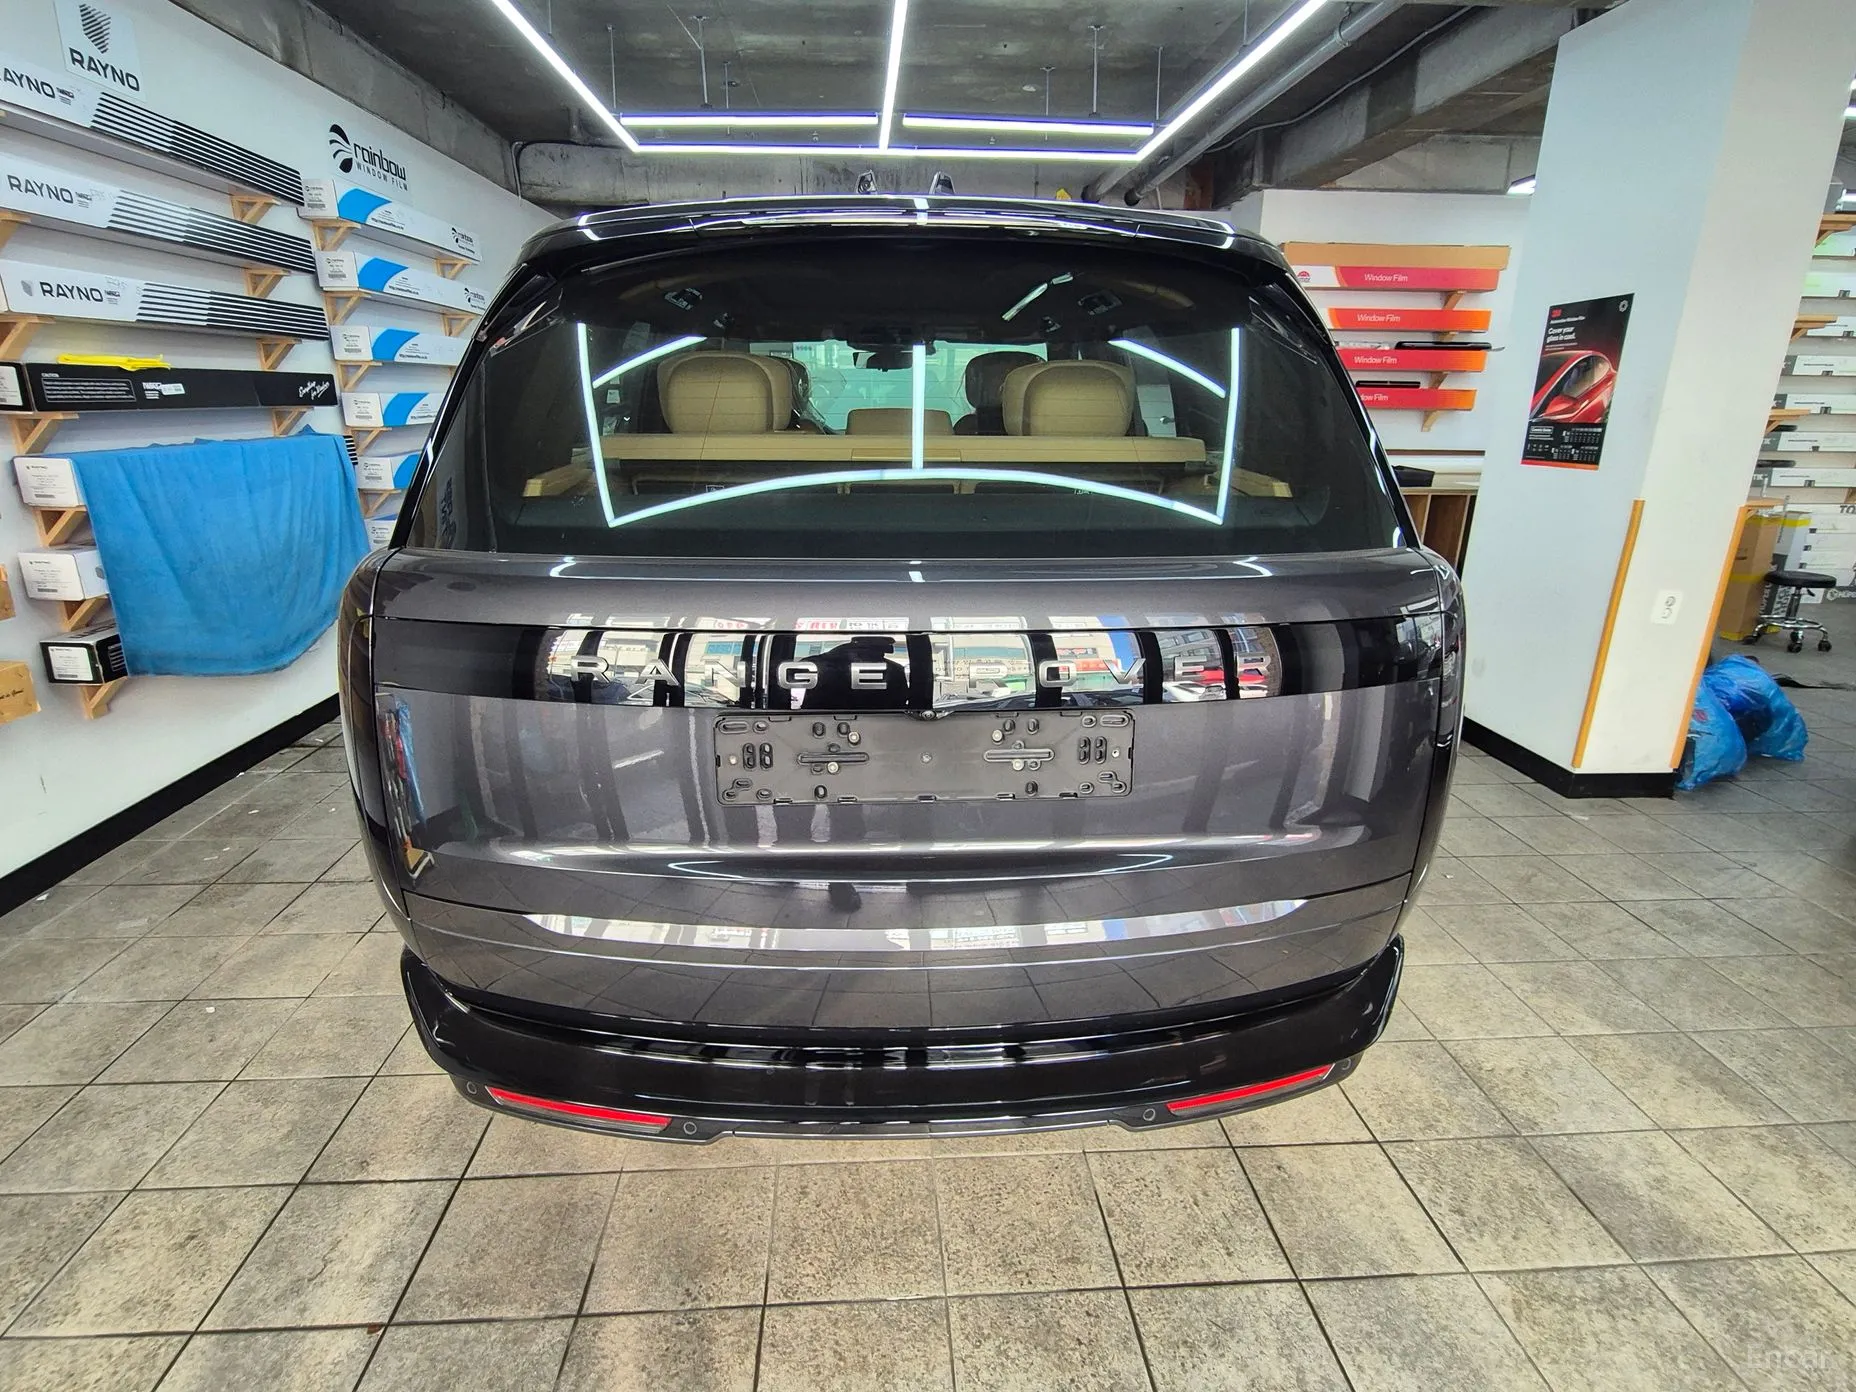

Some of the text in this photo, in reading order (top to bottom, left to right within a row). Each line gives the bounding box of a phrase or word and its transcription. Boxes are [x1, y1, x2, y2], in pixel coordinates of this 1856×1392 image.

[0, 67, 56, 99] AYNO
[69, 47, 140, 91] RAYNO
[353, 142, 407, 181] rainbow
[356, 160, 408, 191] WINDOW FILM
[7, 174, 74, 204] RAYNO
[39, 281, 104, 303] RAYNO
[1364, 273, 1408, 282] Window Film
[1357, 314, 1401, 322] Window Film
[1354, 356, 1398, 364] Window Film
[1374, 393, 1389, 401] Film
[571, 655, 1272, 690] RANGE ROVER
